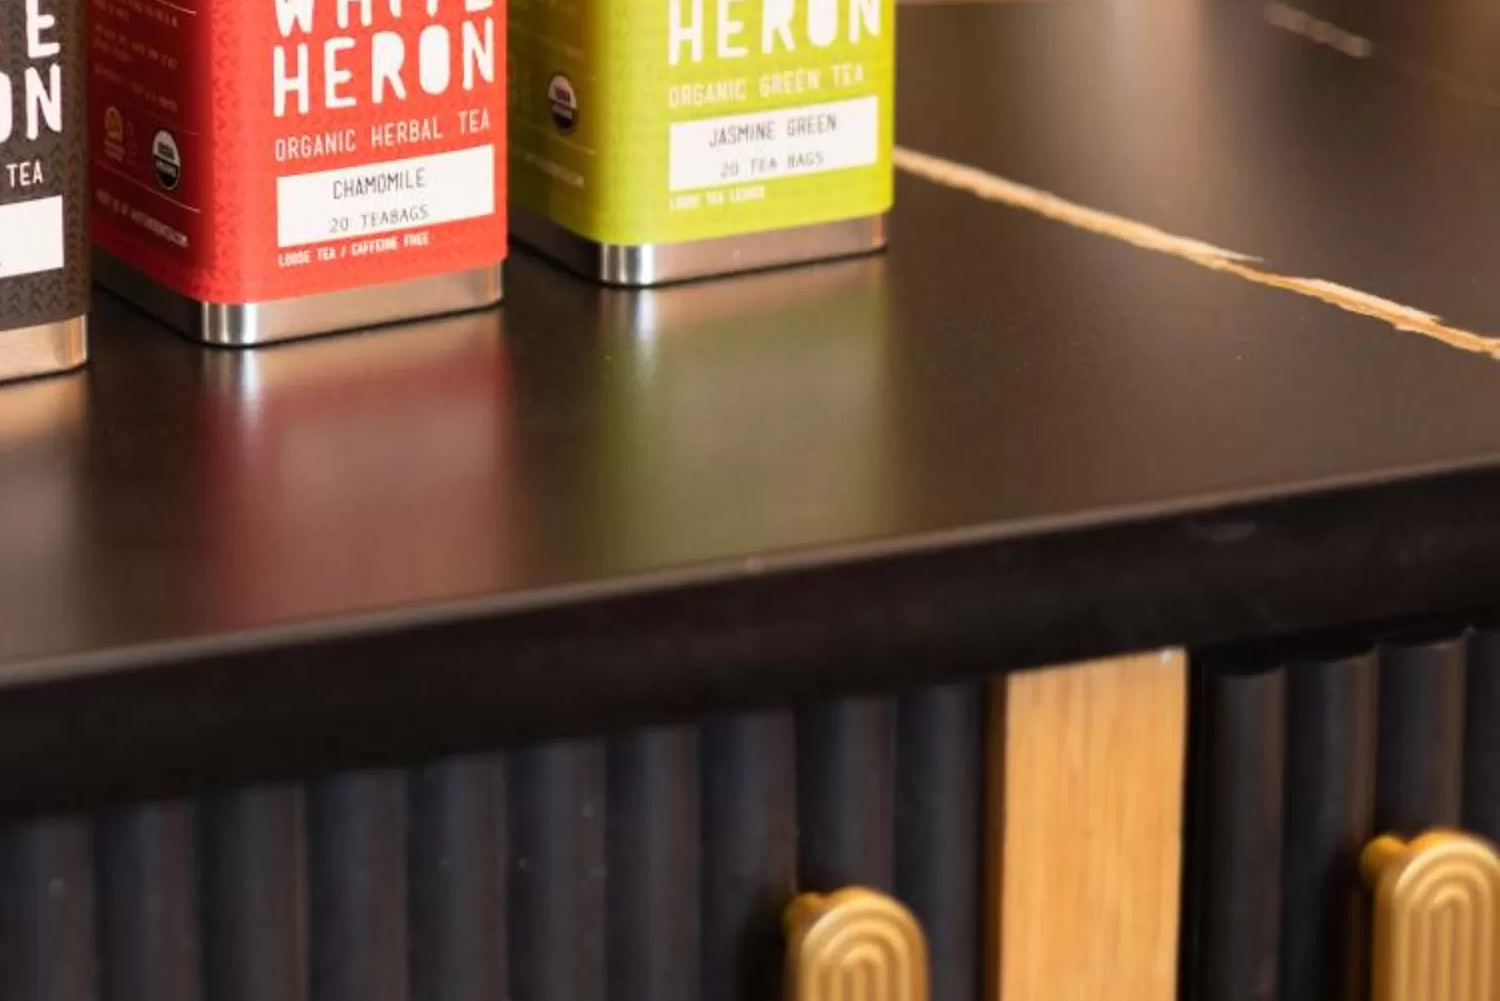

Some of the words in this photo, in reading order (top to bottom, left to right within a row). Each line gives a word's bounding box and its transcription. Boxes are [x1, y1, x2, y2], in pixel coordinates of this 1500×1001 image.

[273, 16, 495, 118] HERON
[668, 77, 747, 109] ORGANIC
[759, 68, 821, 98] GREEN
[832, 63, 864, 87] TEA
[274, 129, 357, 162] ORGANIC
[371, 116, 443, 148] HERBAL
[457, 107, 490, 135] TEA
[708, 119, 776, 149] JASMINE
[786, 112, 837, 137] GREEN
[6, 160, 44, 188] TEA
[332, 167, 426, 200] CHAMOMILE
[329, 216, 349, 234] 20
[360, 203, 430, 232] TEABAGS
